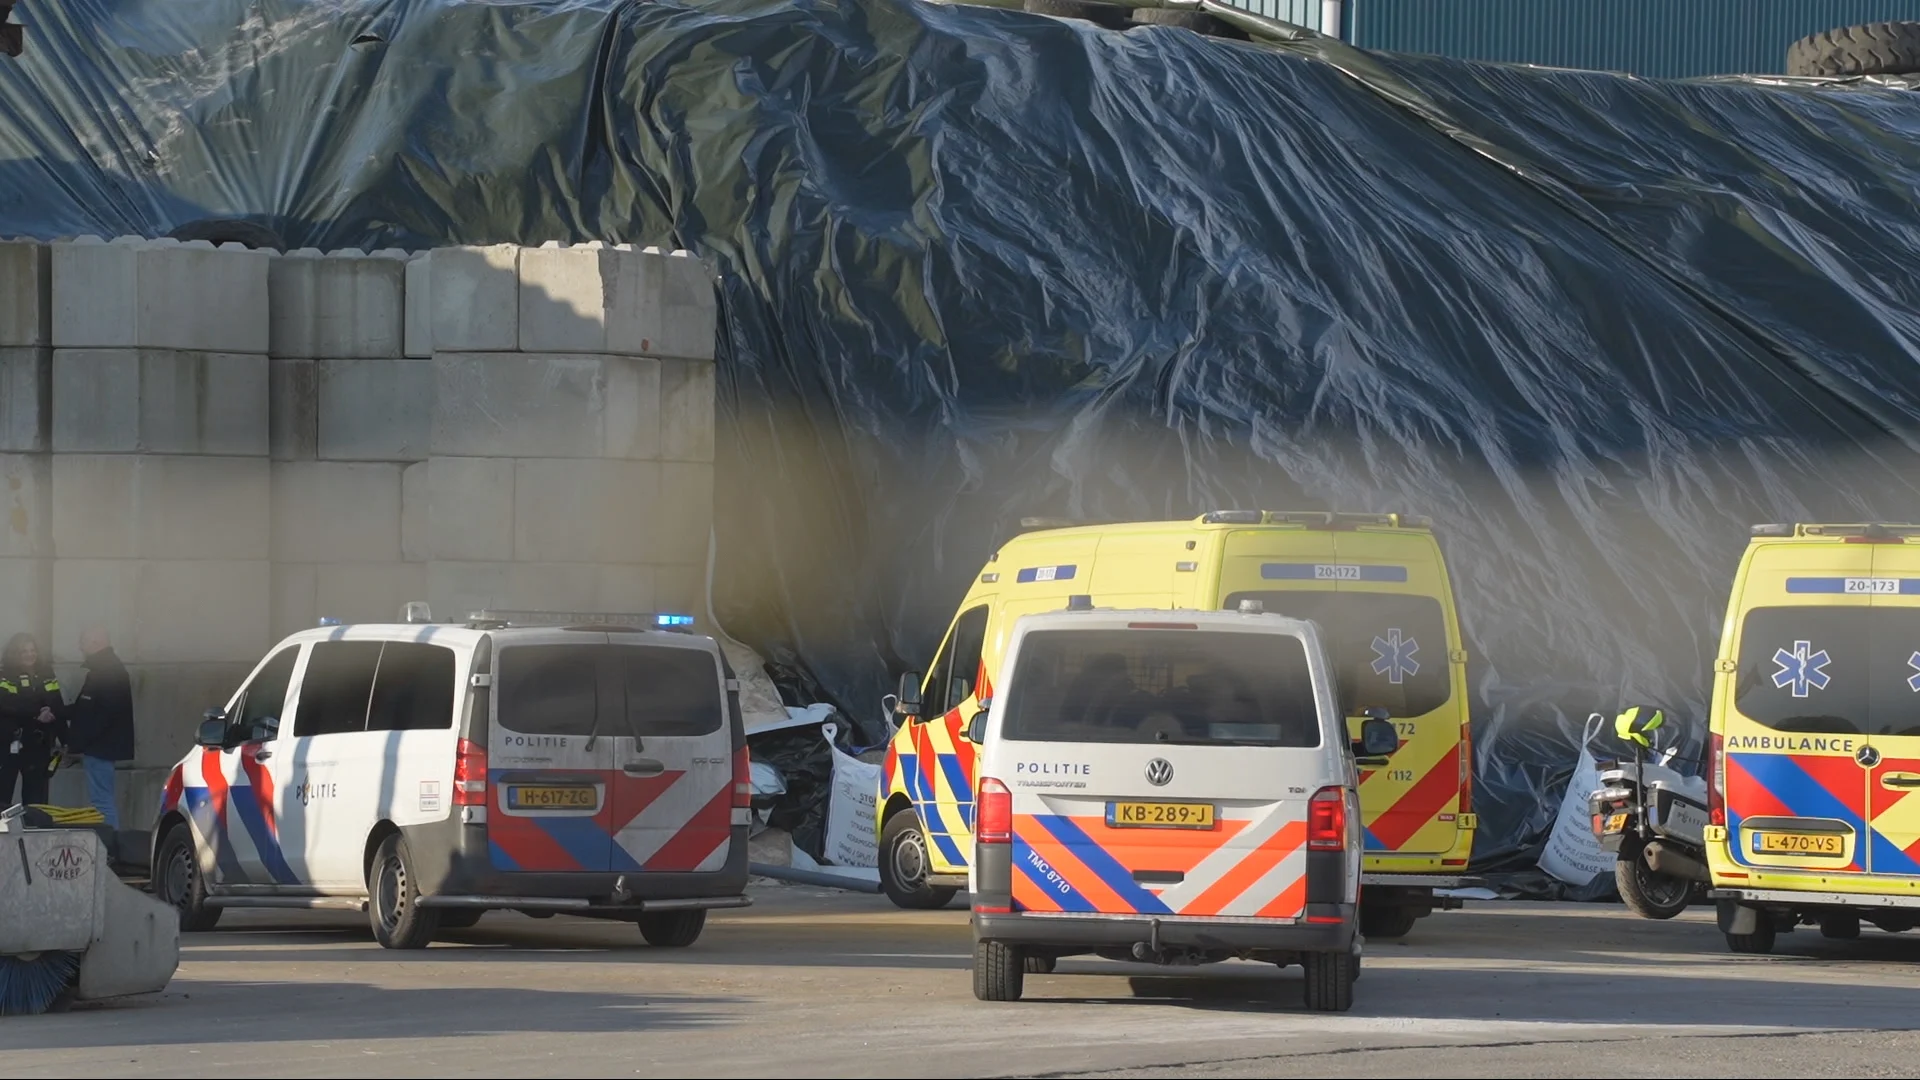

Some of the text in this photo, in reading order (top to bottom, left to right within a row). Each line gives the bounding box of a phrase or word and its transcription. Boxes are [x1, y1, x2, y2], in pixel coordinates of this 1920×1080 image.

[1318, 566, 1357, 578] 20-172
[1848, 580, 1895, 592] 20-173
[505, 736, 567, 748] POLITIE
[1728, 735, 1853, 753] AMBULANCE
[1017, 762, 1091, 775] POLITIE
[1393, 770, 1413, 781] 112
[524, 790, 589, 805] H-617-ZG
[1122, 806, 1206, 824] KB-289-J
[1767, 836, 1835, 851] L-470-VS
[49, 867, 80, 879] SWEEP
[1027, 849, 1071, 894] TMC 8710
